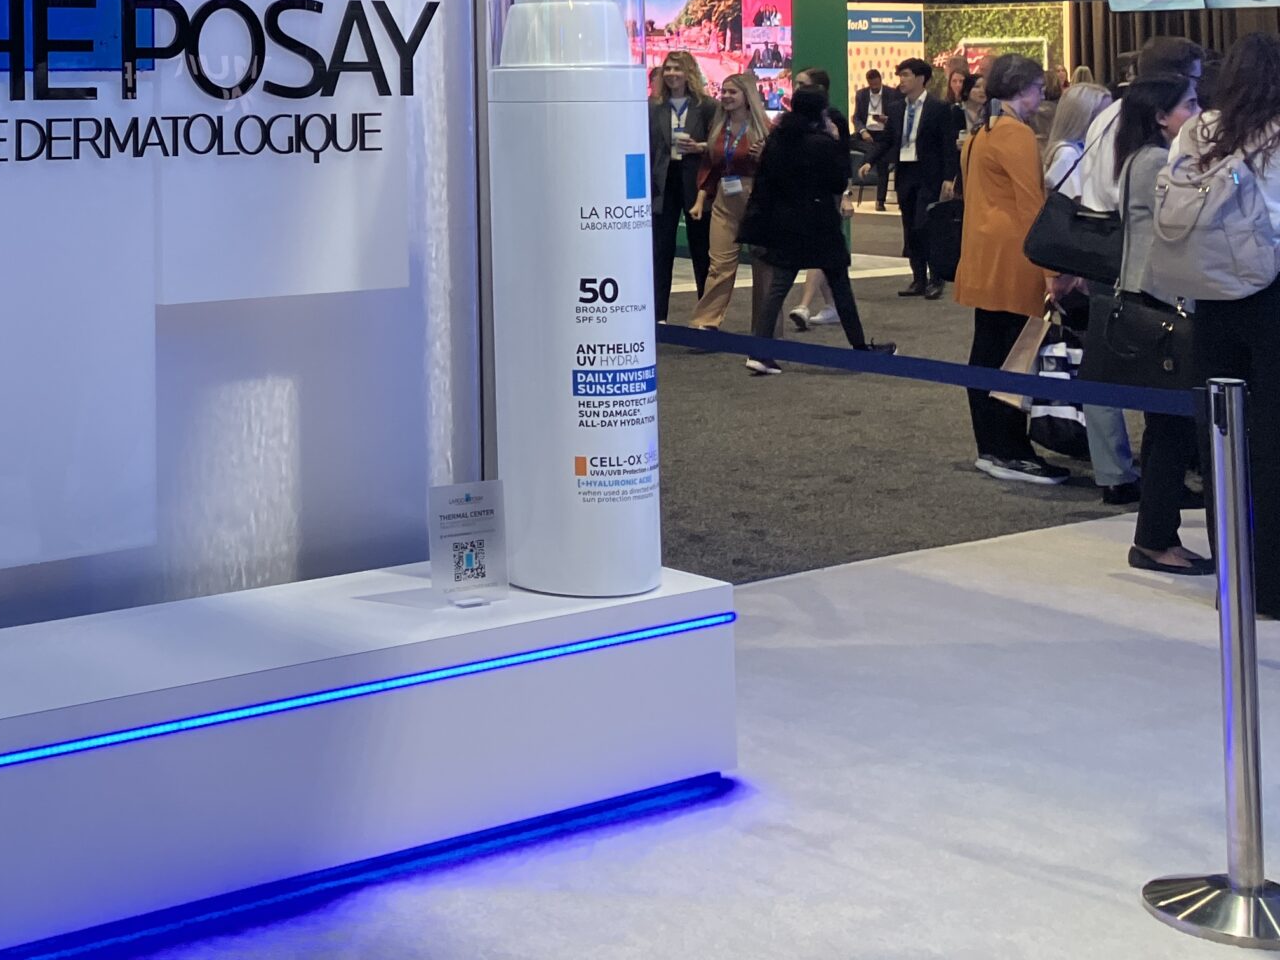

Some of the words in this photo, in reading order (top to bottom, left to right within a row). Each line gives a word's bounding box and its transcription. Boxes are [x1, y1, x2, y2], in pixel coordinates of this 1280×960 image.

[15, 112, 382, 164] DERMATOLOGIQUE
[580, 206, 600, 220] LA
[580, 221, 632, 231] LABORATOIRE
[578, 277, 619, 304] 50
[575, 306, 608, 314] BROAD
[609, 304, 647, 313] SPECTRUM
[575, 316, 594, 324] SPF
[596, 316, 608, 324] 50
[576, 341, 645, 355] ANTHELIOS
[576, 355, 597, 366] UV
[600, 354, 641, 367] HYDRA
[577, 372, 614, 383] DAILY
[616, 368, 655, 383] INVISIBLE
[577, 381, 647, 395] SUNSCREEN
[578, 400, 610, 408] HELPS
[612, 397, 647, 408] PROTECT
[578, 410, 600, 418] SUN
[578, 419, 618, 428] ALL-DAY
[619, 415, 655, 427] HYDRATION
[589, 454, 642, 468] CELL-OX
[597, 494, 632, 503] protection
[603, 488, 622, 497] used
[439, 511, 469, 521] THERMAL
[469, 508, 495, 518] CENTER
